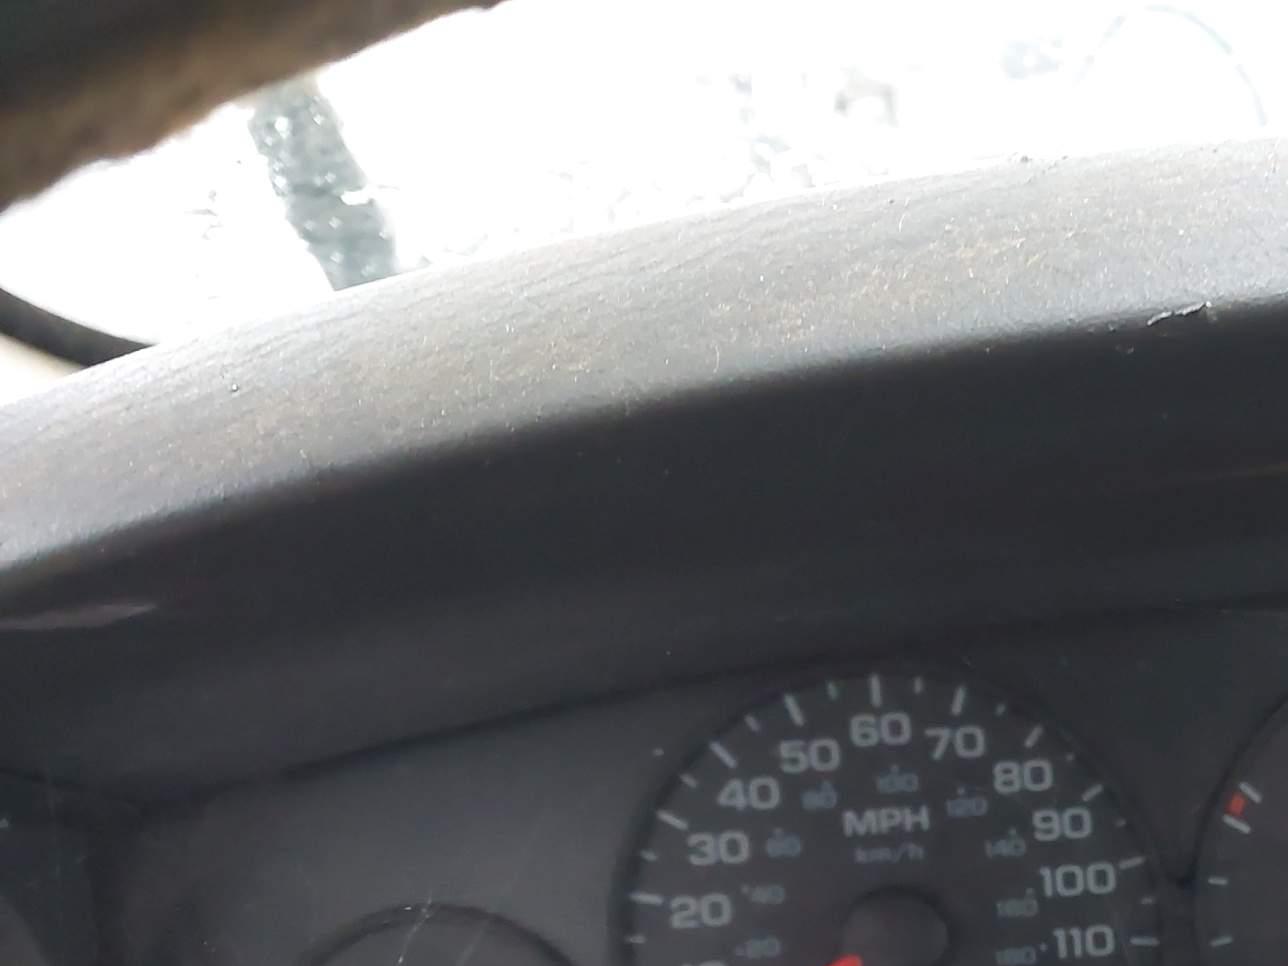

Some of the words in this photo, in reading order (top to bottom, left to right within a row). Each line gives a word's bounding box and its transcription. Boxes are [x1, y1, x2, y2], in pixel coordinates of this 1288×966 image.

[850, 713, 912, 747] 60
[925, 726, 985, 760] 70
[779, 738, 841, 773] 50
[717, 776, 781, 811] 40
[993, 759, 1053, 794] 80
[842, 805, 930, 837] MPH
[1032, 806, 1092, 841] 90
[687, 830, 750, 866] 30
[1039, 862, 1116, 897] 100
[670, 893, 733, 929] 20
[1053, 924, 1115, 959] 110
